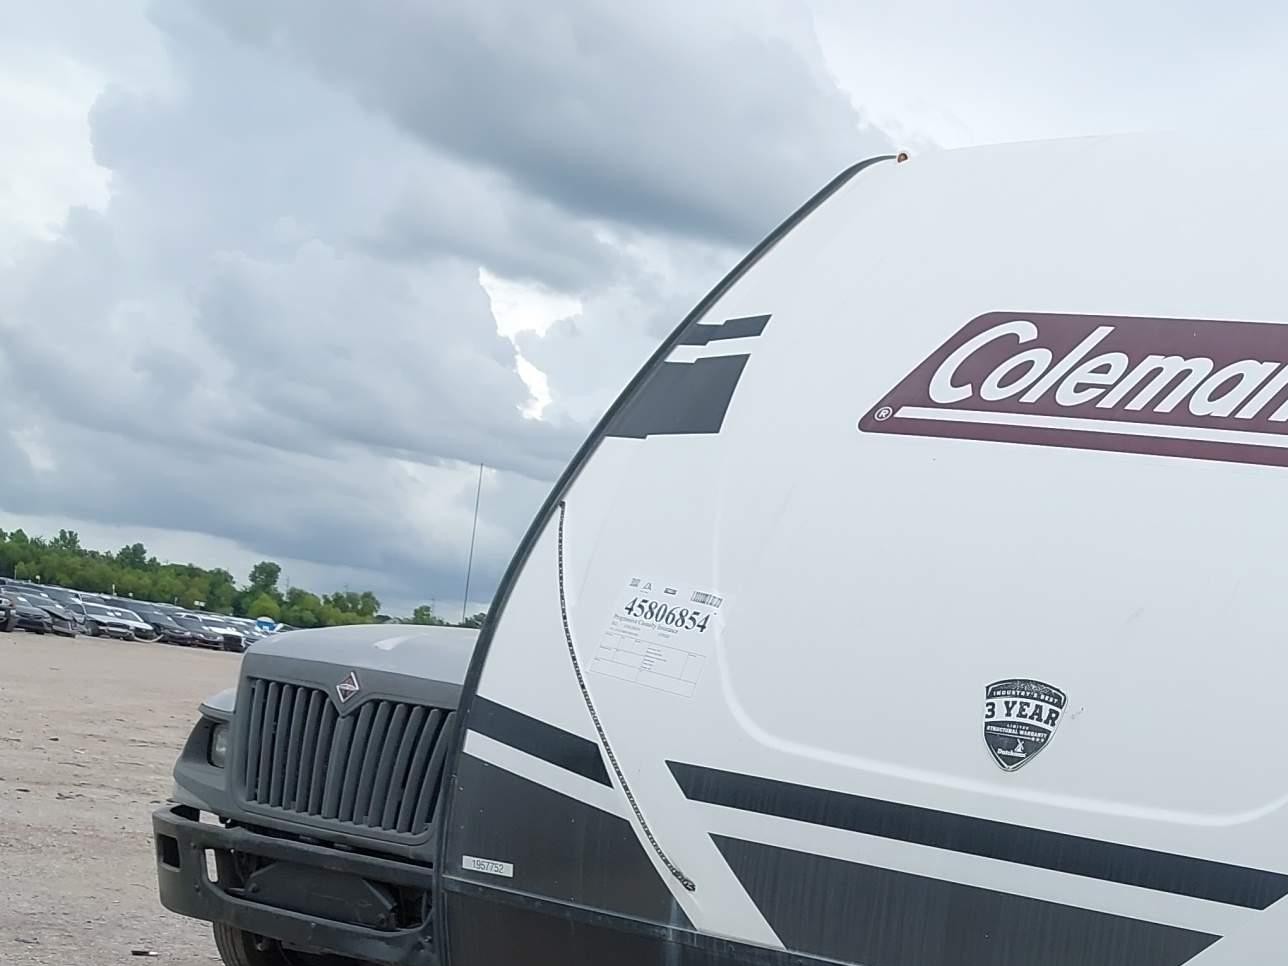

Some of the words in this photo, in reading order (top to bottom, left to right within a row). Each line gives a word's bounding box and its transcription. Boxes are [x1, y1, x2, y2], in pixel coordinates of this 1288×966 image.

[624, 596, 711, 633] 45806854
[985, 701, 996, 719] 3
[1004, 700, 1060, 727] YEAR
